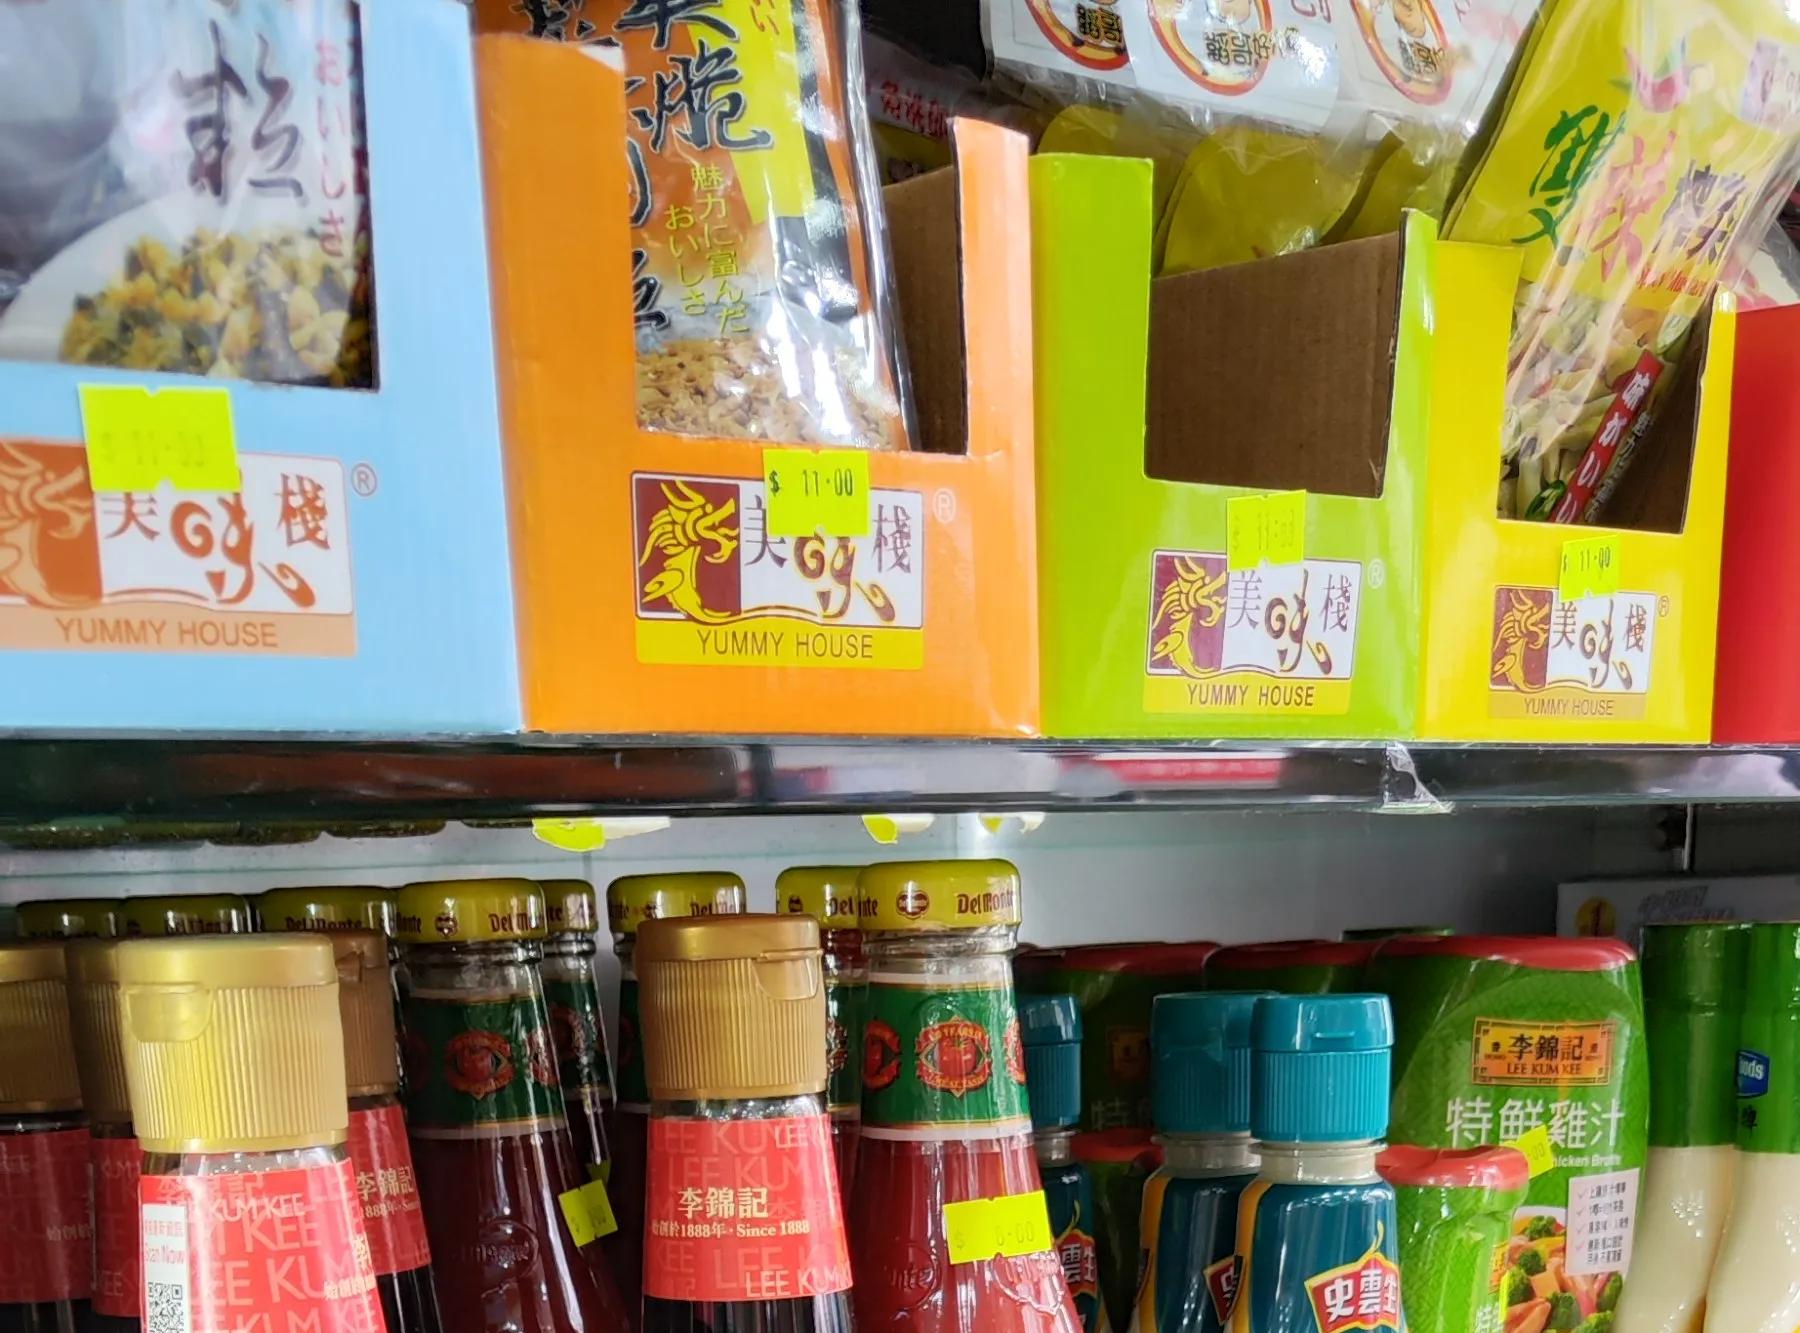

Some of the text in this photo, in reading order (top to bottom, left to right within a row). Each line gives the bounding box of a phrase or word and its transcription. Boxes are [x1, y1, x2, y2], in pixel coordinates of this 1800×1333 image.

[664, 204, 708, 317] おいしさ
[690, 164, 751, 335] 魅力に富んだ
[55, 617, 279, 648] YUMMY HOUSE
[696, 629, 874, 659] YUMMY HOUSE
[1185, 683, 1316, 708] YUMMY HOUSE
[1523, 696, 1614, 717] YUMMY HOUSE
[956, 892, 982, 916] Del
[1508, 1033, 1585, 1062] 李錦記
[1506, 1062, 1530, 1075] LEE
[1530, 1063, 1560, 1075] KUM
[1445, 1094, 1626, 1151] 特鮮雞汁
[355, 1165, 414, 1201] 李錦記
[677, 1186, 769, 1220] 李錦記
[735, 1219, 812, 1238] Since 1888
[1322, 1268, 1398, 1323] 史雲生
